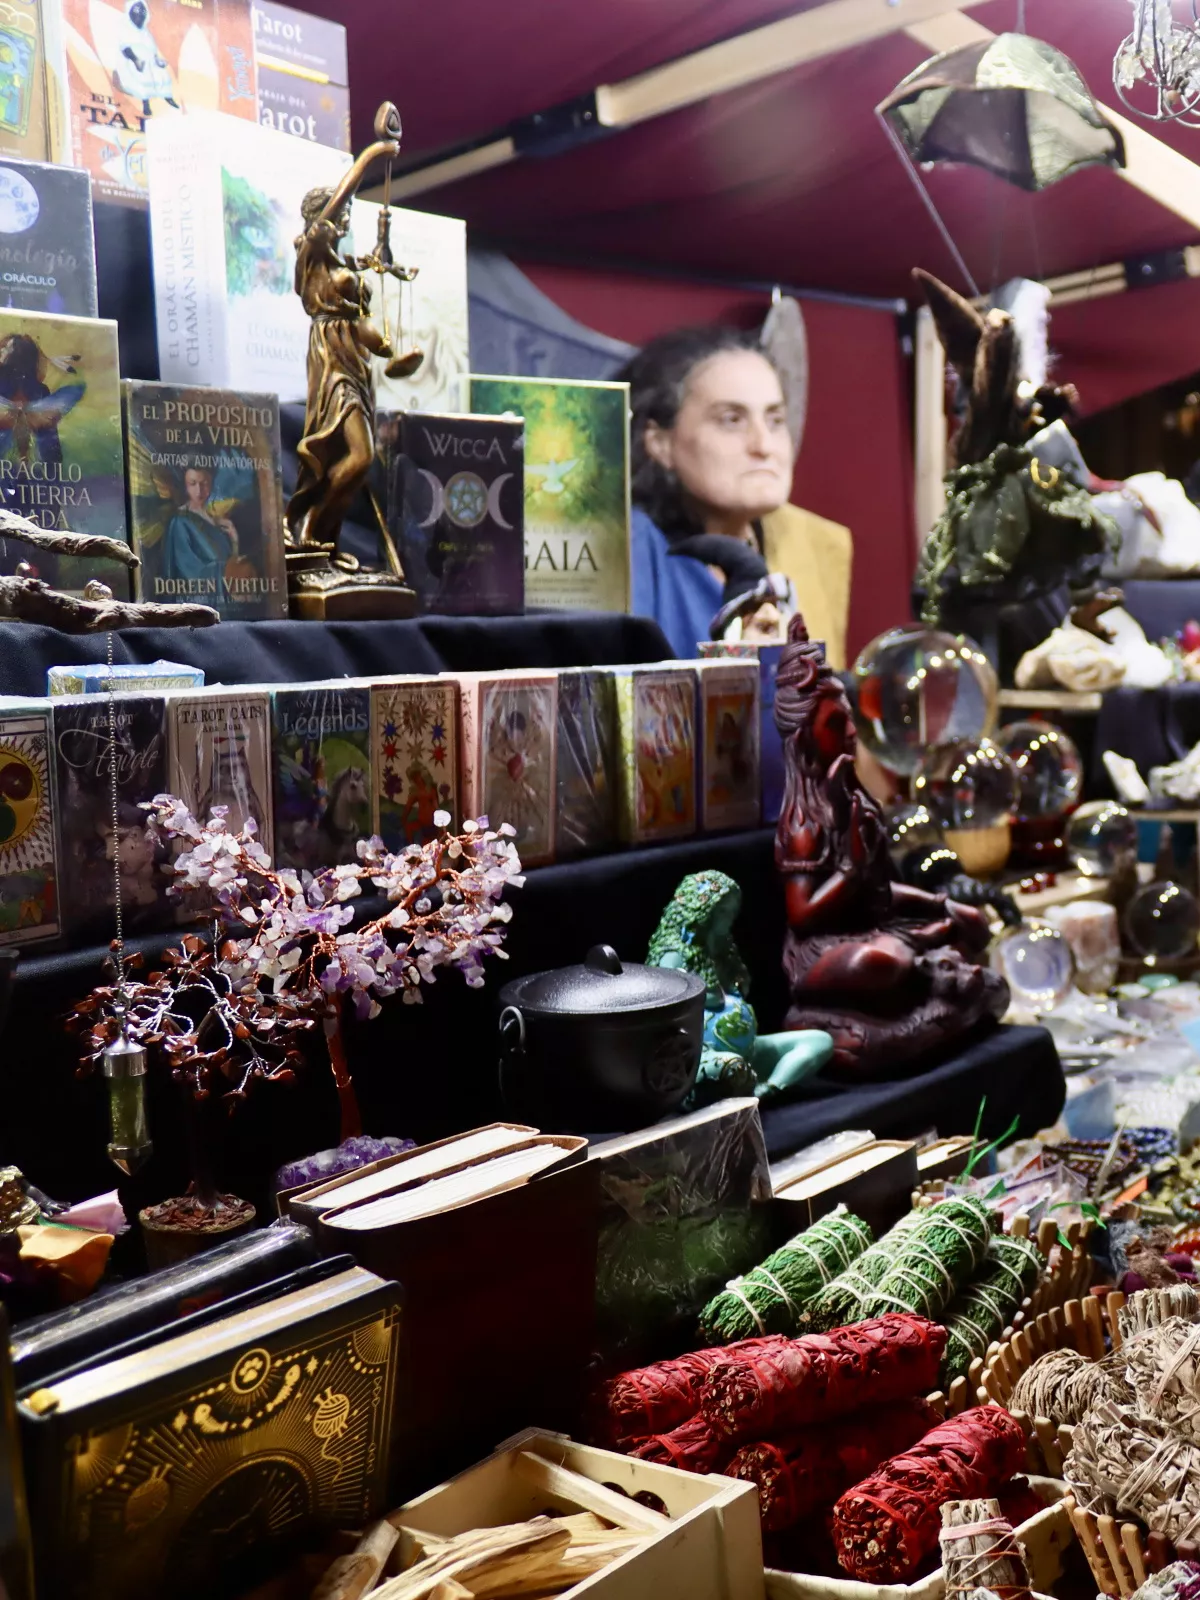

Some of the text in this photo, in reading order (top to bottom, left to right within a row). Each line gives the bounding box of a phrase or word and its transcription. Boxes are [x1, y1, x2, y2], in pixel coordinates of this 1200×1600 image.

[91, 92, 121, 107] EL
[260, 100, 318, 141] arot
[142, 404, 160, 420] EL
[166, 426, 254, 447] DE LA VIDA
[150, 452, 189, 467] CARTAS
[17, 484, 93, 507] TIERRA
[153, 576, 280, 595] DOREEN VIRTUE
[181, 705, 262, 724] TAROT CATS
